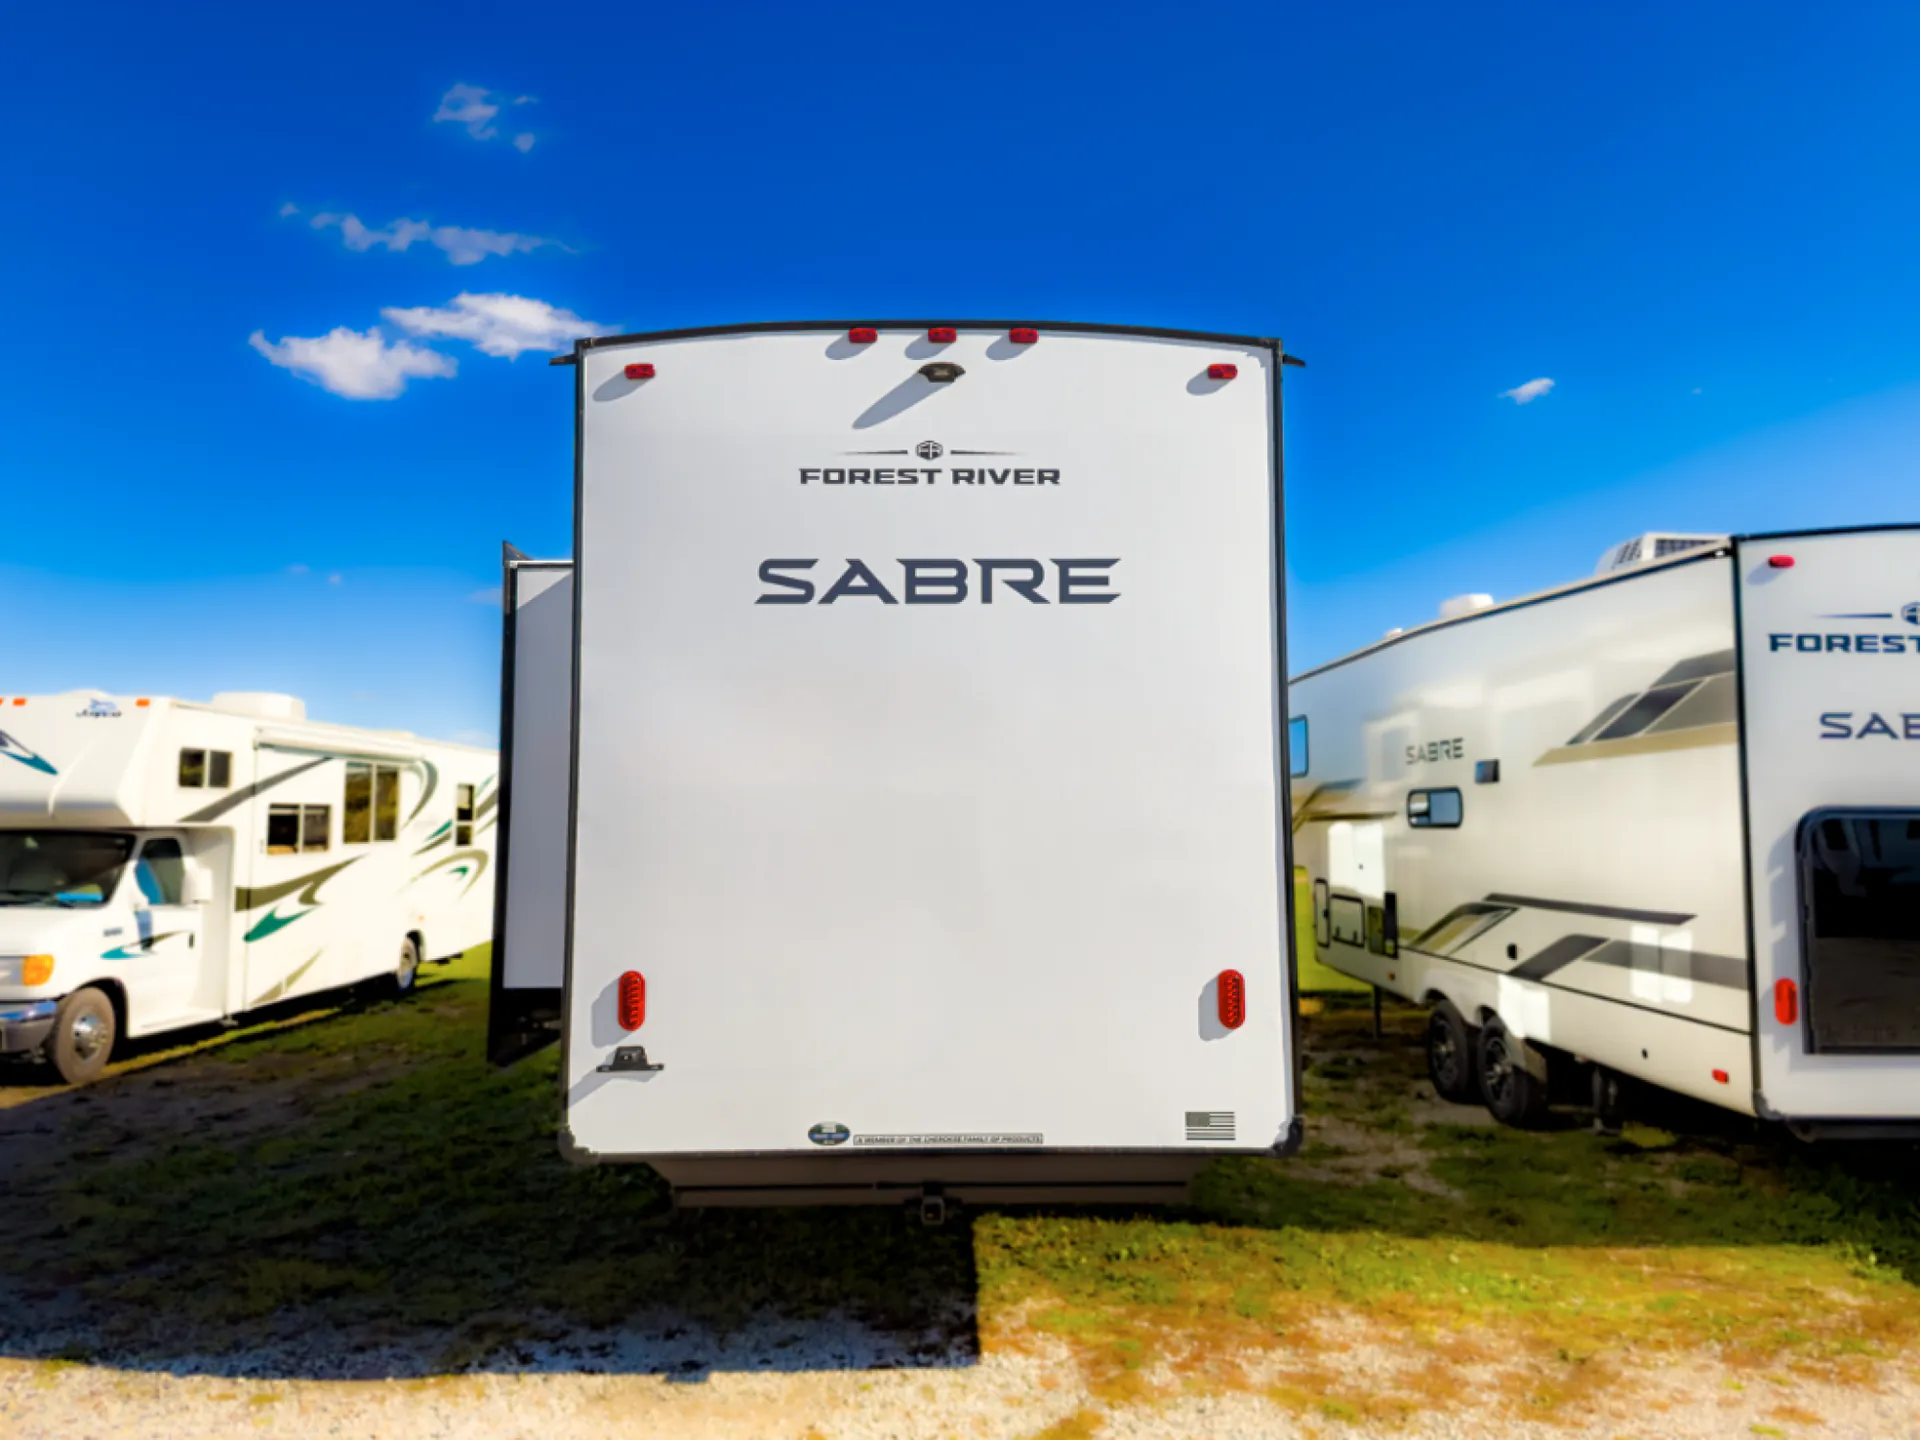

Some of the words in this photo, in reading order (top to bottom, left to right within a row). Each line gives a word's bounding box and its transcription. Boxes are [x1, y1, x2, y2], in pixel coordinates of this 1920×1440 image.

[799, 468, 942, 485] FOREST
[951, 468, 1060, 485] RIVER
[754, 558, 1122, 604] SABRE
[1405, 737, 1463, 766] SABRE
